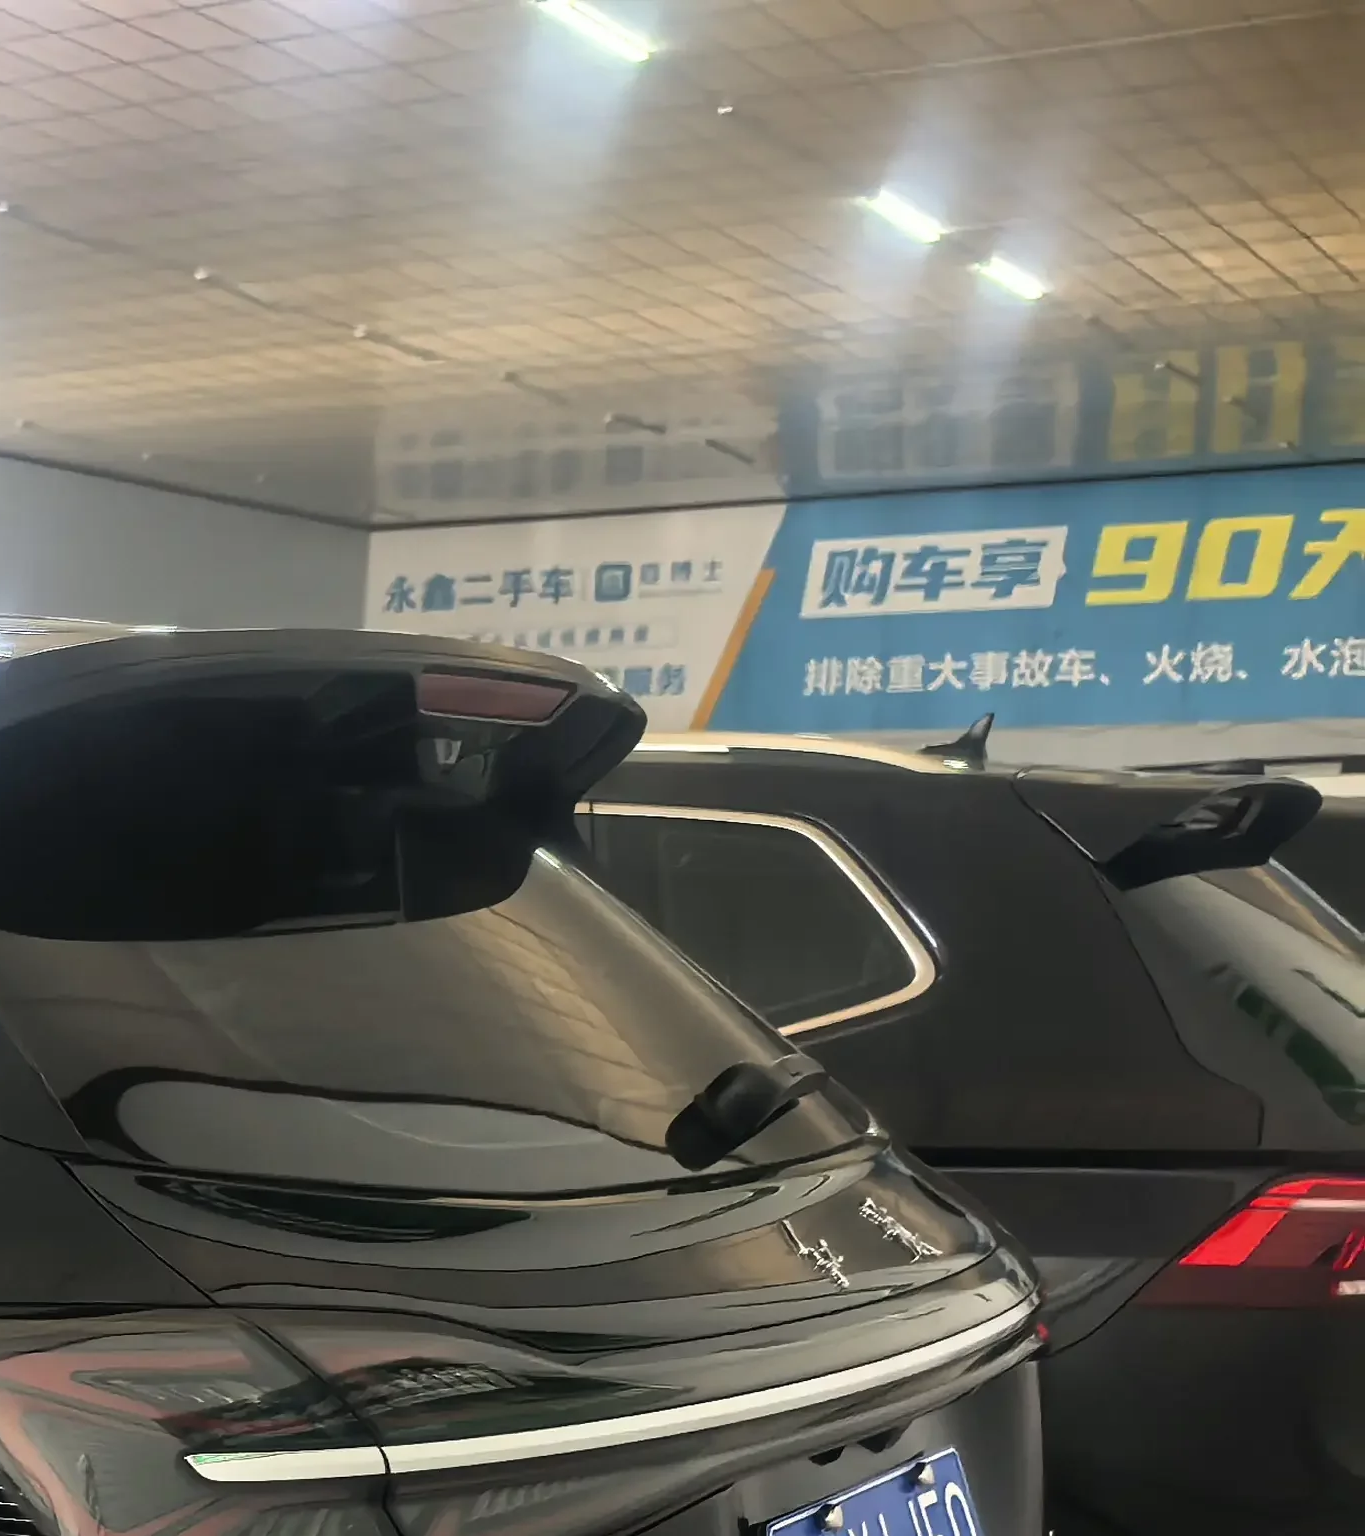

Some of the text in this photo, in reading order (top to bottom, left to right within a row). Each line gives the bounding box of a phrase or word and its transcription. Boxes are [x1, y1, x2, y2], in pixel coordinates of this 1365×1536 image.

[818, 508, 1365, 608] 购车享 90天
